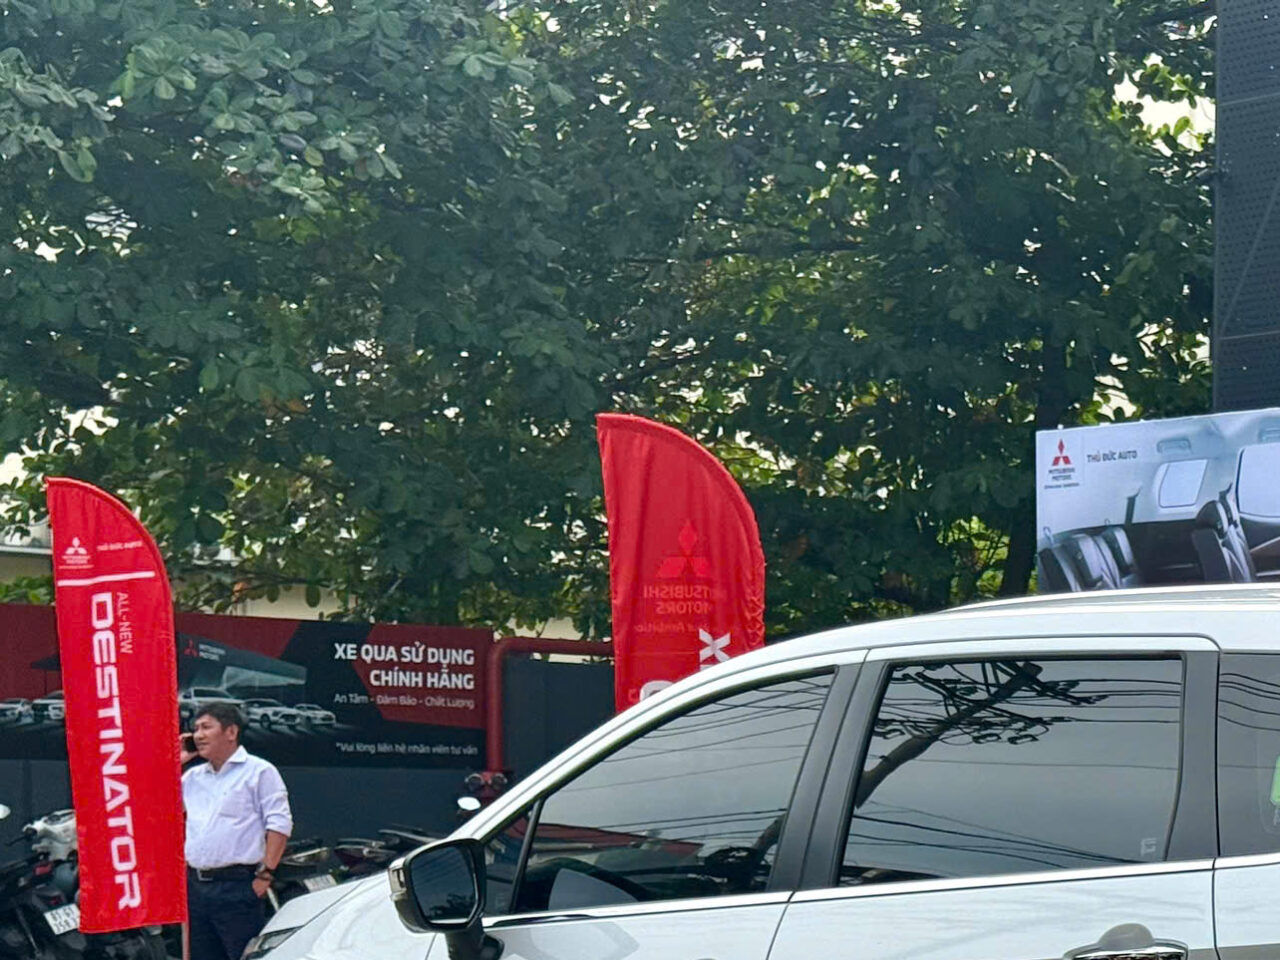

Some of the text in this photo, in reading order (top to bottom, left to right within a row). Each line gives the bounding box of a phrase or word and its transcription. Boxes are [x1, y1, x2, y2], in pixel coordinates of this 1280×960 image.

[116, 592, 133, 654] ALL-NEW
[334, 641, 475, 669] XE QUA SỬ DỤNG
[369, 666, 475, 690] CHÍNH HÃNG
[334, 693, 348, 704] An
[91, 592, 141, 910] DESTINATOR
